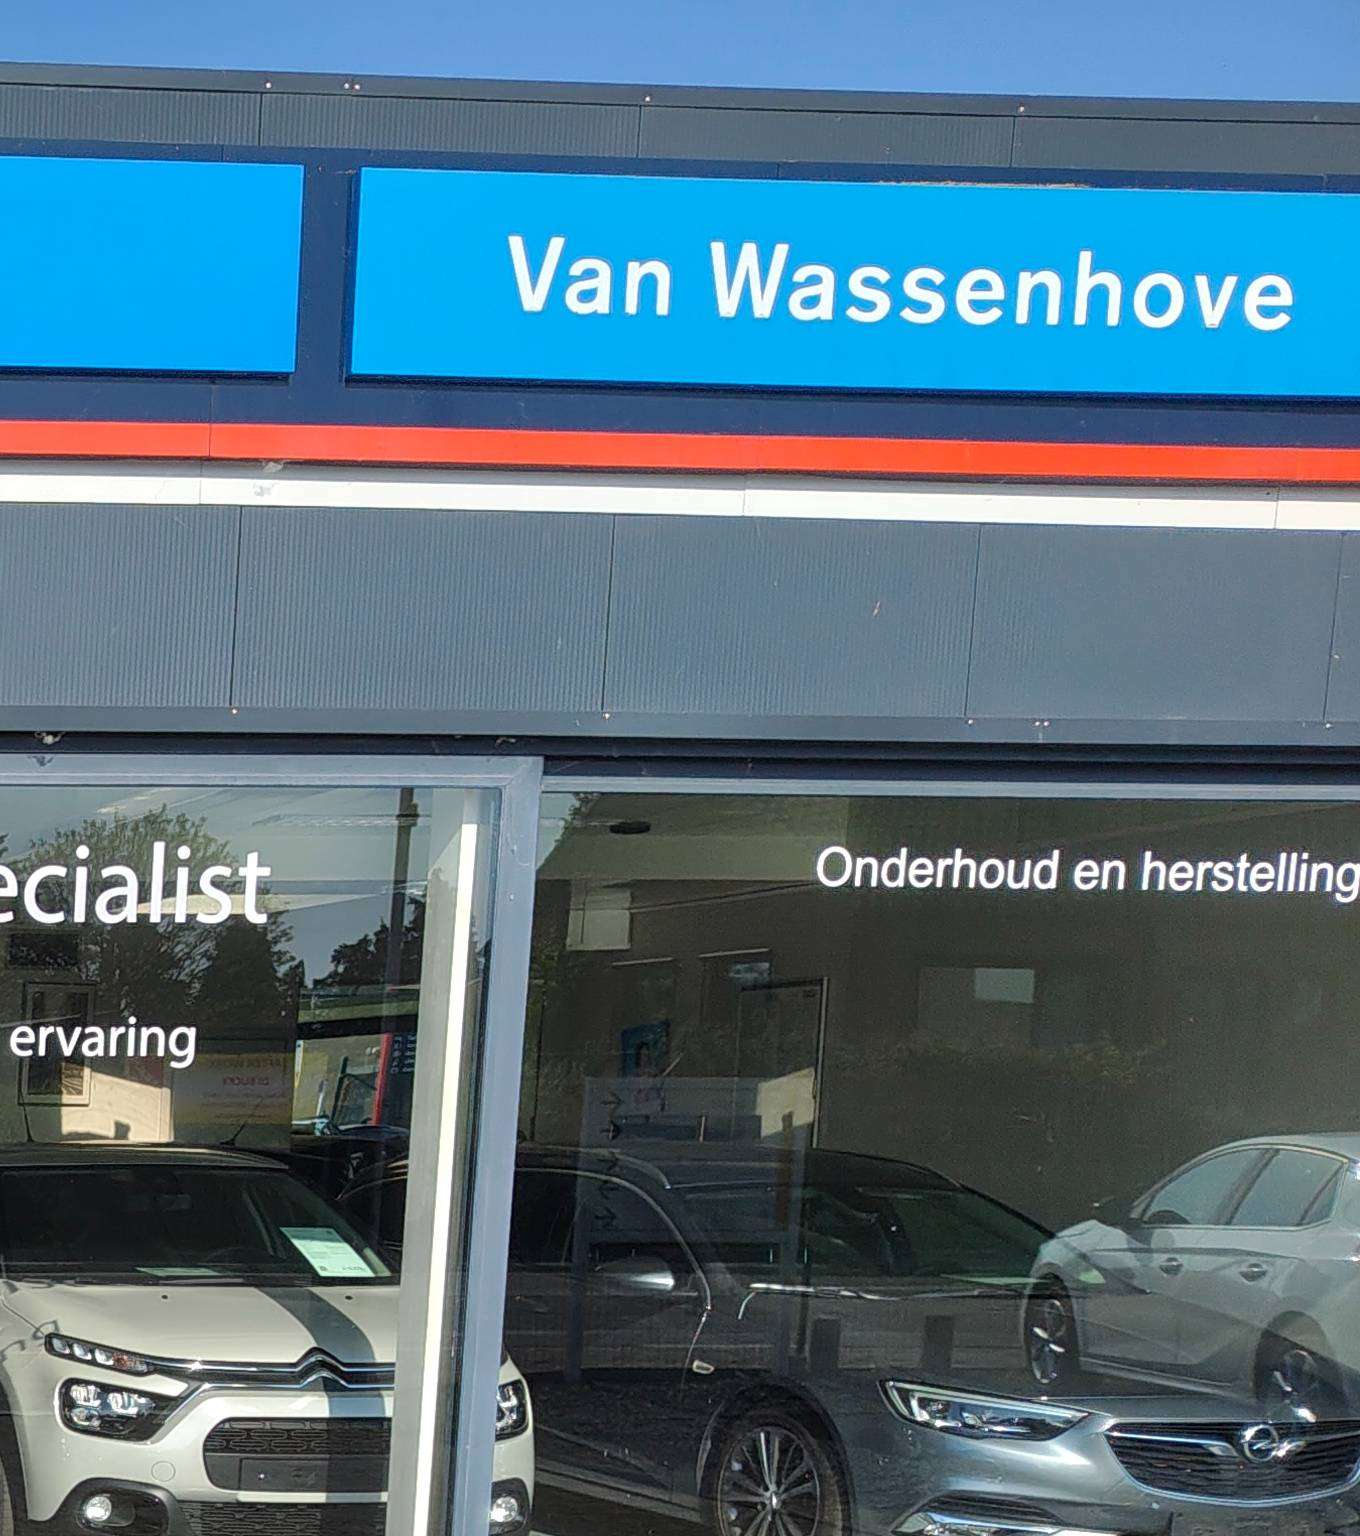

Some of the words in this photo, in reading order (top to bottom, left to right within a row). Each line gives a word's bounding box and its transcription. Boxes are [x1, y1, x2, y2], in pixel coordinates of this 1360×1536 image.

[507, 235, 672, 316] Van
[710, 241, 1294, 331] Wassenhove
[815, 845, 1060, 891] Onderhoud
[1073, 858, 1127, 891] en
[1141, 850, 1360, 904] herstelling
[9, 1015, 197, 1070] ervaring
